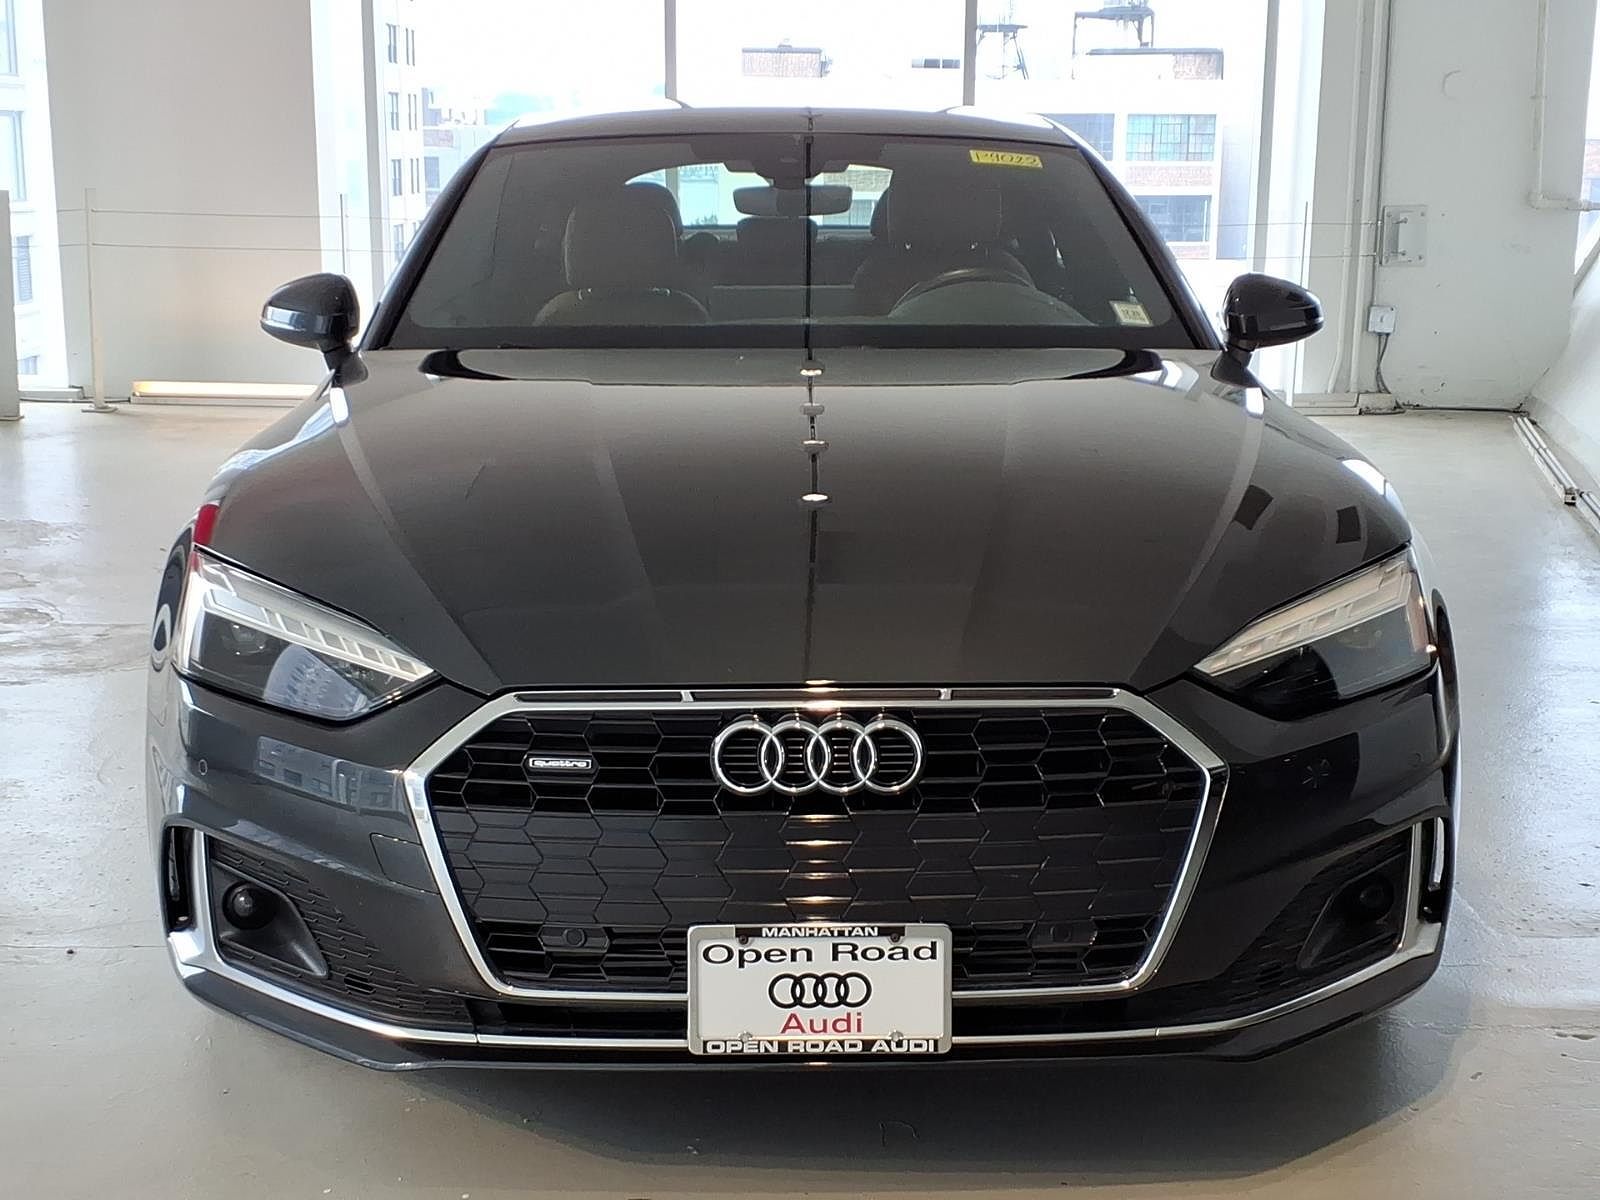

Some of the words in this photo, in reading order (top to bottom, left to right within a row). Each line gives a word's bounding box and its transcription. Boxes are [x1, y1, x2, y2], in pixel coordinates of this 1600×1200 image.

[533, 760, 587, 768] quattro
[761, 926, 879, 938] MANHATTAN
[702, 944, 813, 968] Open
[831, 941, 938, 962] Road
[780, 1012, 864, 1034] Audi
[706, 1039, 779, 1053] OPEN
[789, 1039, 862, 1053] ROAD
[871, 1039, 935, 1053] AUDI
